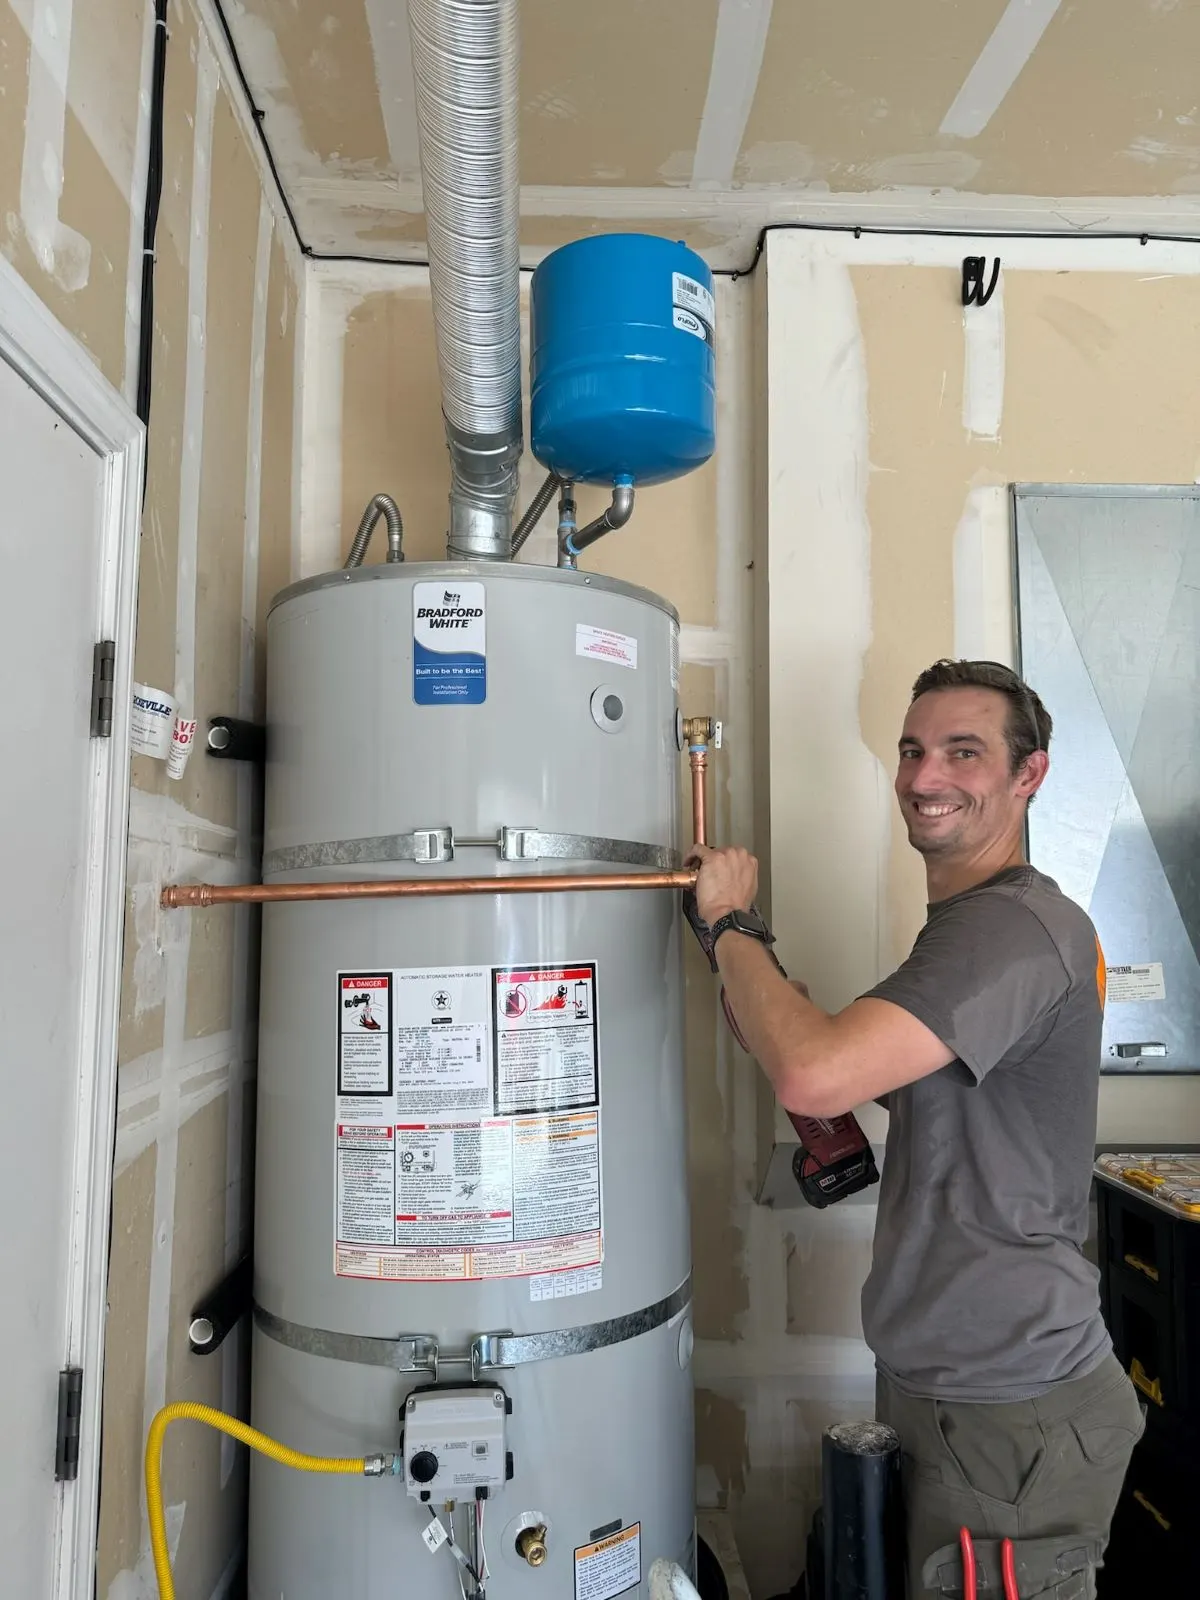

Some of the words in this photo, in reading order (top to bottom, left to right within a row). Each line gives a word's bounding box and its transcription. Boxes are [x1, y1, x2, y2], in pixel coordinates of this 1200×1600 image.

[417, 608, 483, 618] BRADFORD
[429, 618, 469, 628] WHITE
[599, 1534, 624, 1550] WARNING
